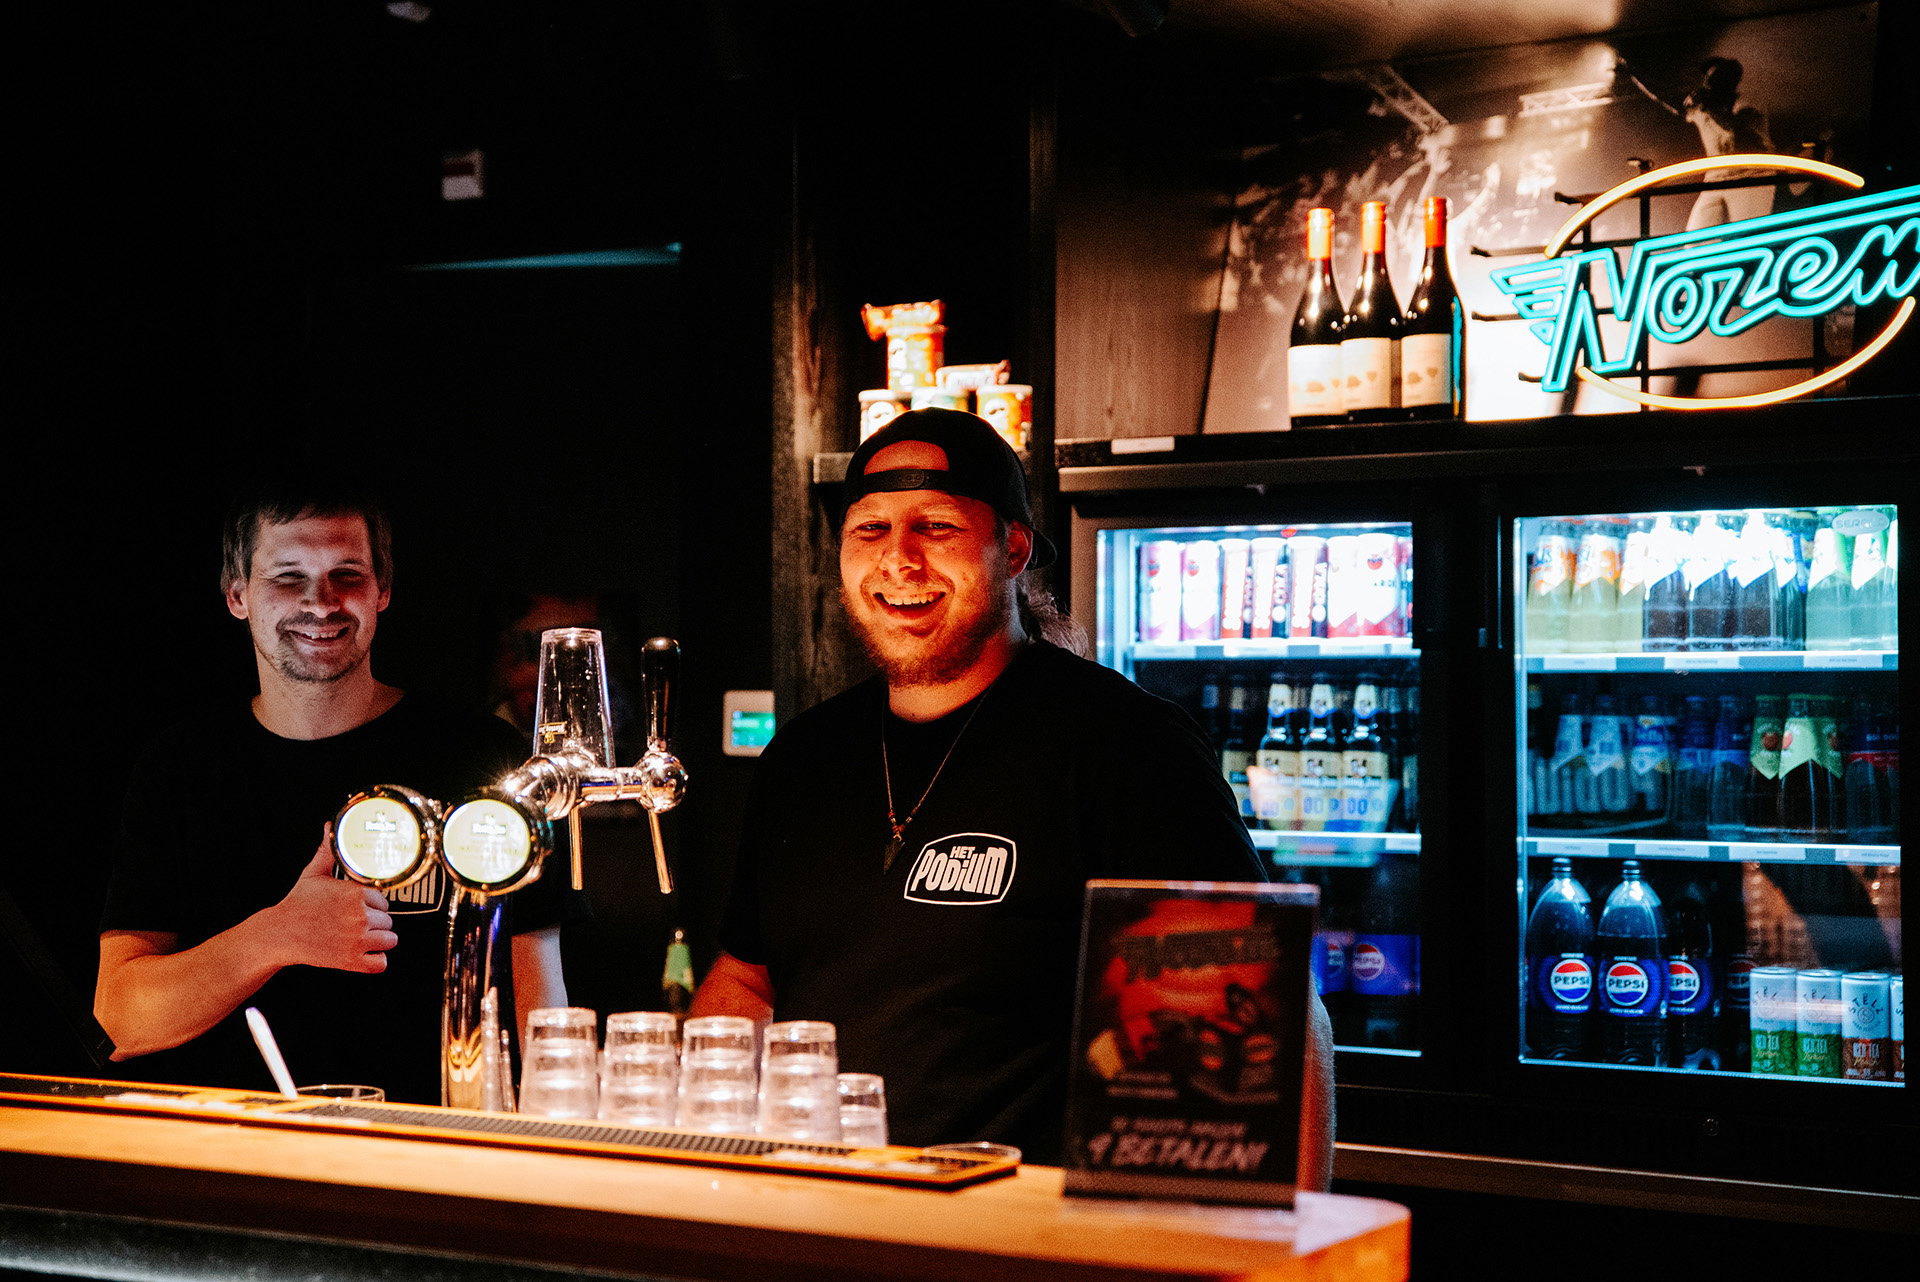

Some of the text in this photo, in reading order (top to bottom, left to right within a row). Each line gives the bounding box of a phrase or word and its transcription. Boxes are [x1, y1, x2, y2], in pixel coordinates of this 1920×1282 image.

[949, 846, 976, 859] HET
[1553, 975, 1590, 986] PEPSI
[1608, 978, 1645, 989] PEPSI
